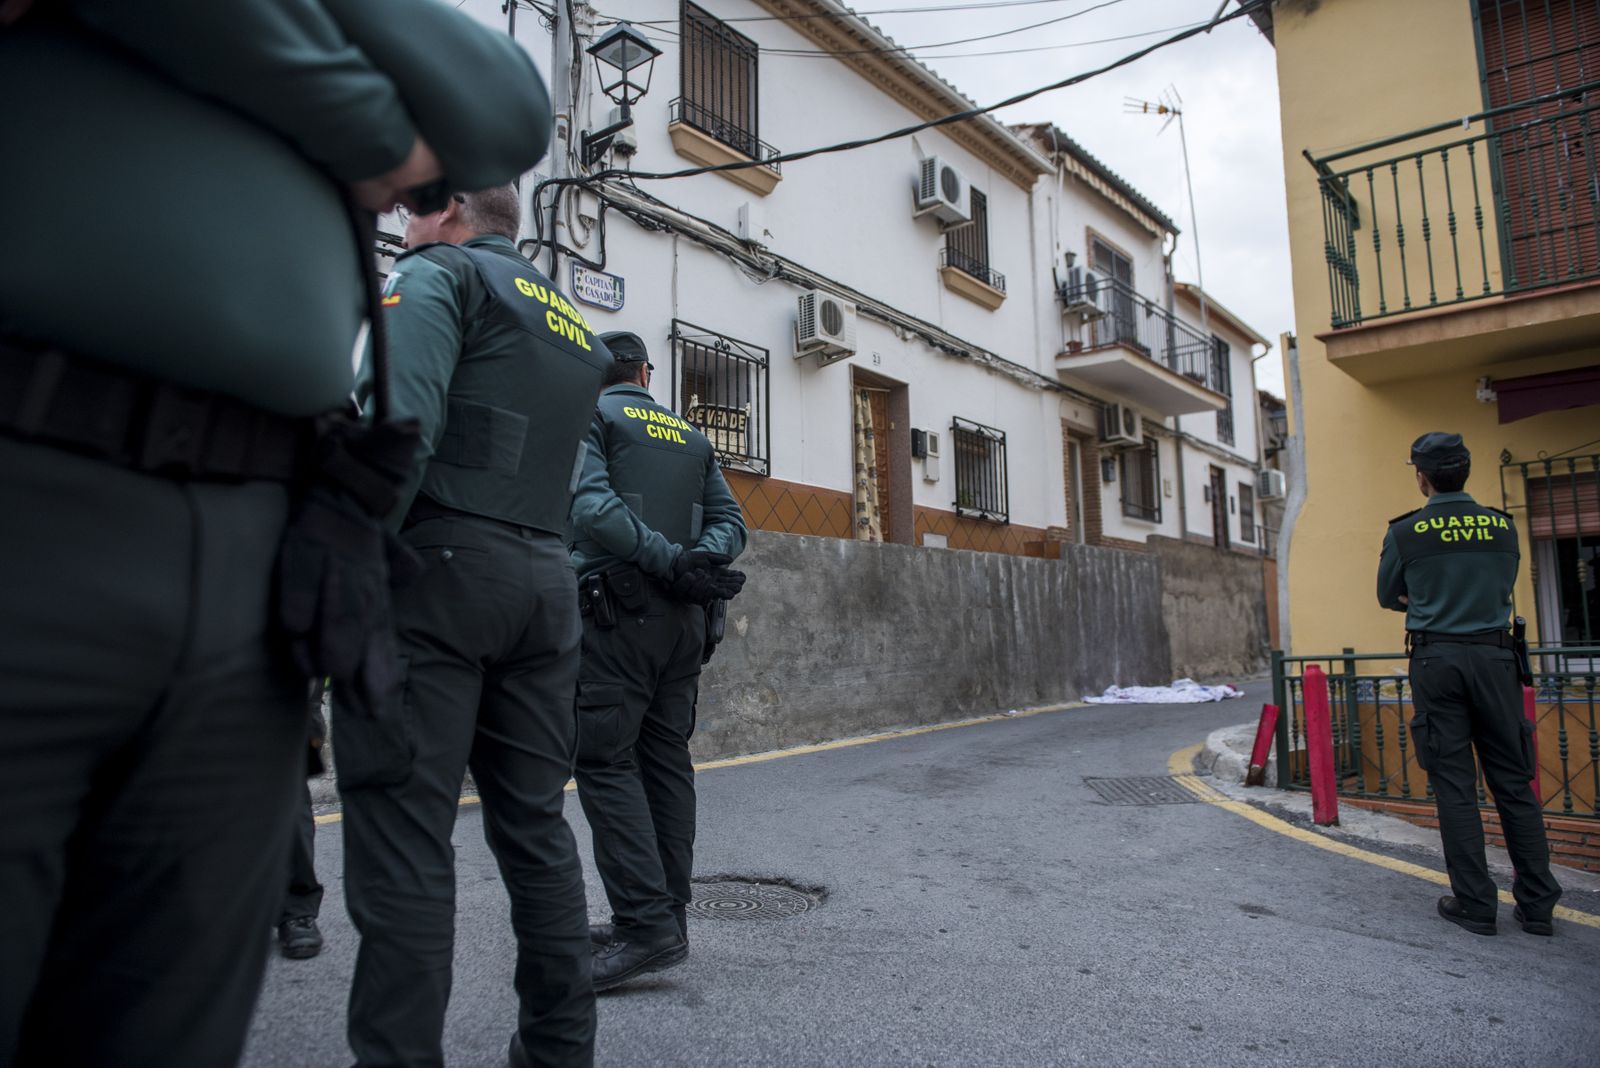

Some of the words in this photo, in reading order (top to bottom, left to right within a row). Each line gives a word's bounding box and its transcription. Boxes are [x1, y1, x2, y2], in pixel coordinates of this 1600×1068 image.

[585, 286, 614, 303] CASADO
[546, 310, 592, 351] CIVIL
[623, 407, 692, 432] GUARDIA
[687, 408, 704, 423] SE
[706, 409, 746, 430] VENDE
[647, 424, 686, 444] CIVIL
[1414, 515, 1509, 533] GUARDIA
[1440, 528, 1493, 542] CIVIL
